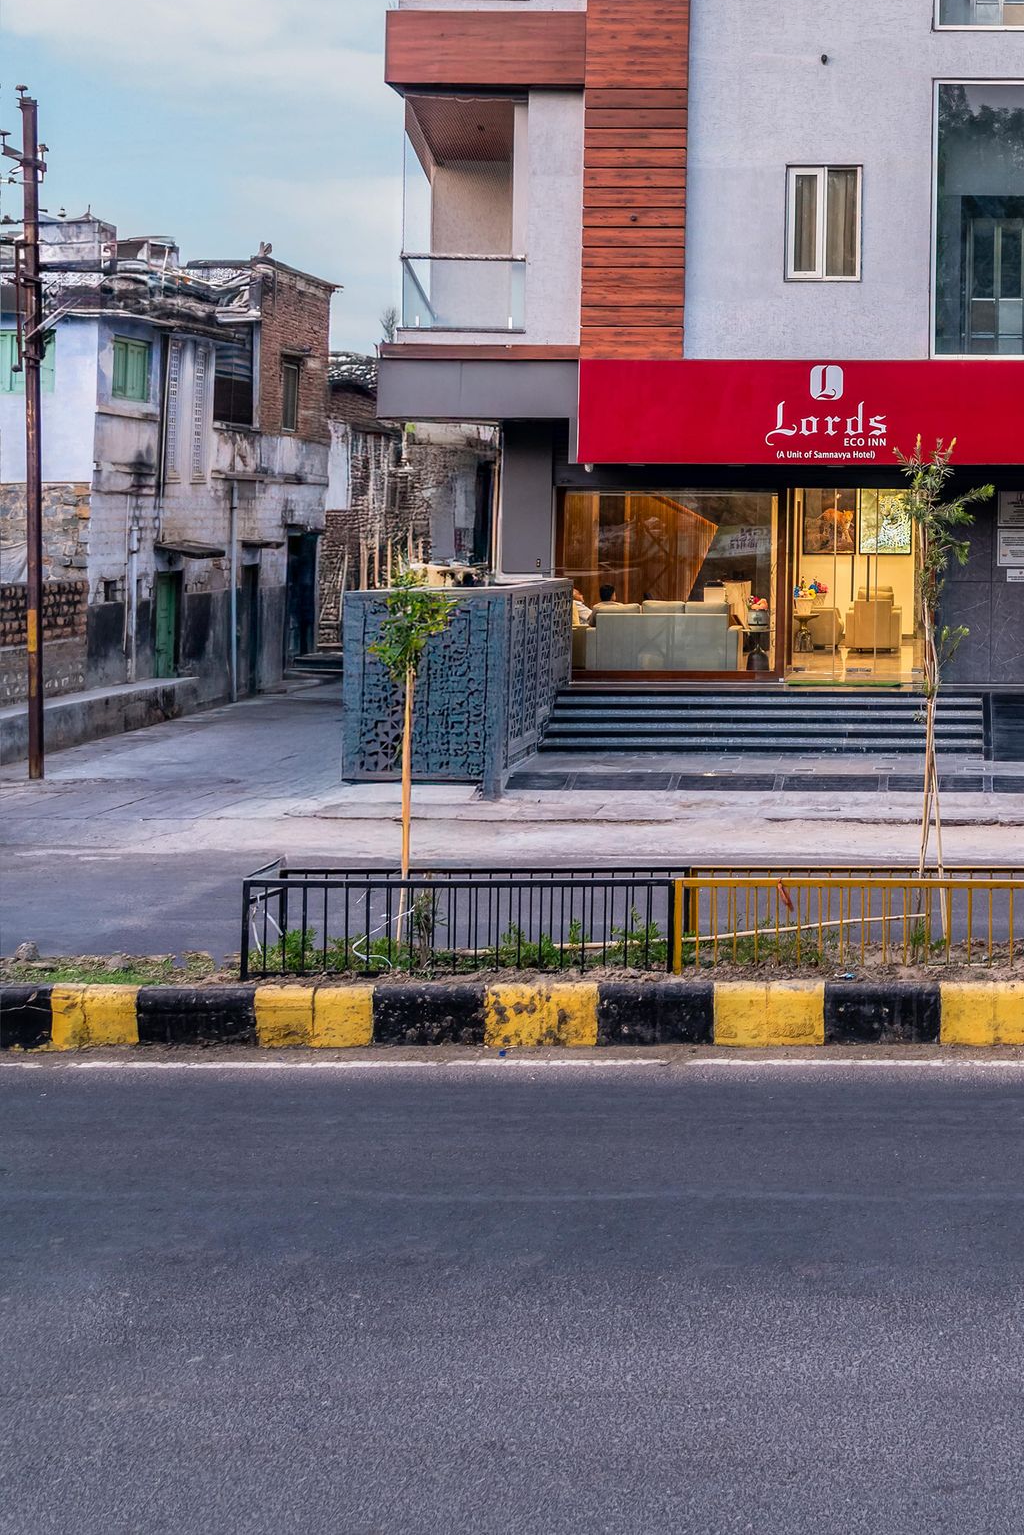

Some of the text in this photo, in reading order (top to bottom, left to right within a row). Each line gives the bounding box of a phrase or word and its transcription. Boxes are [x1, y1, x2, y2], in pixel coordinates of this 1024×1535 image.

[765, 401, 888, 446] Lords
[843, 437, 887, 447] ECO INN
[776, 450, 876, 460] (A Unit of Samnavya Hotel)
